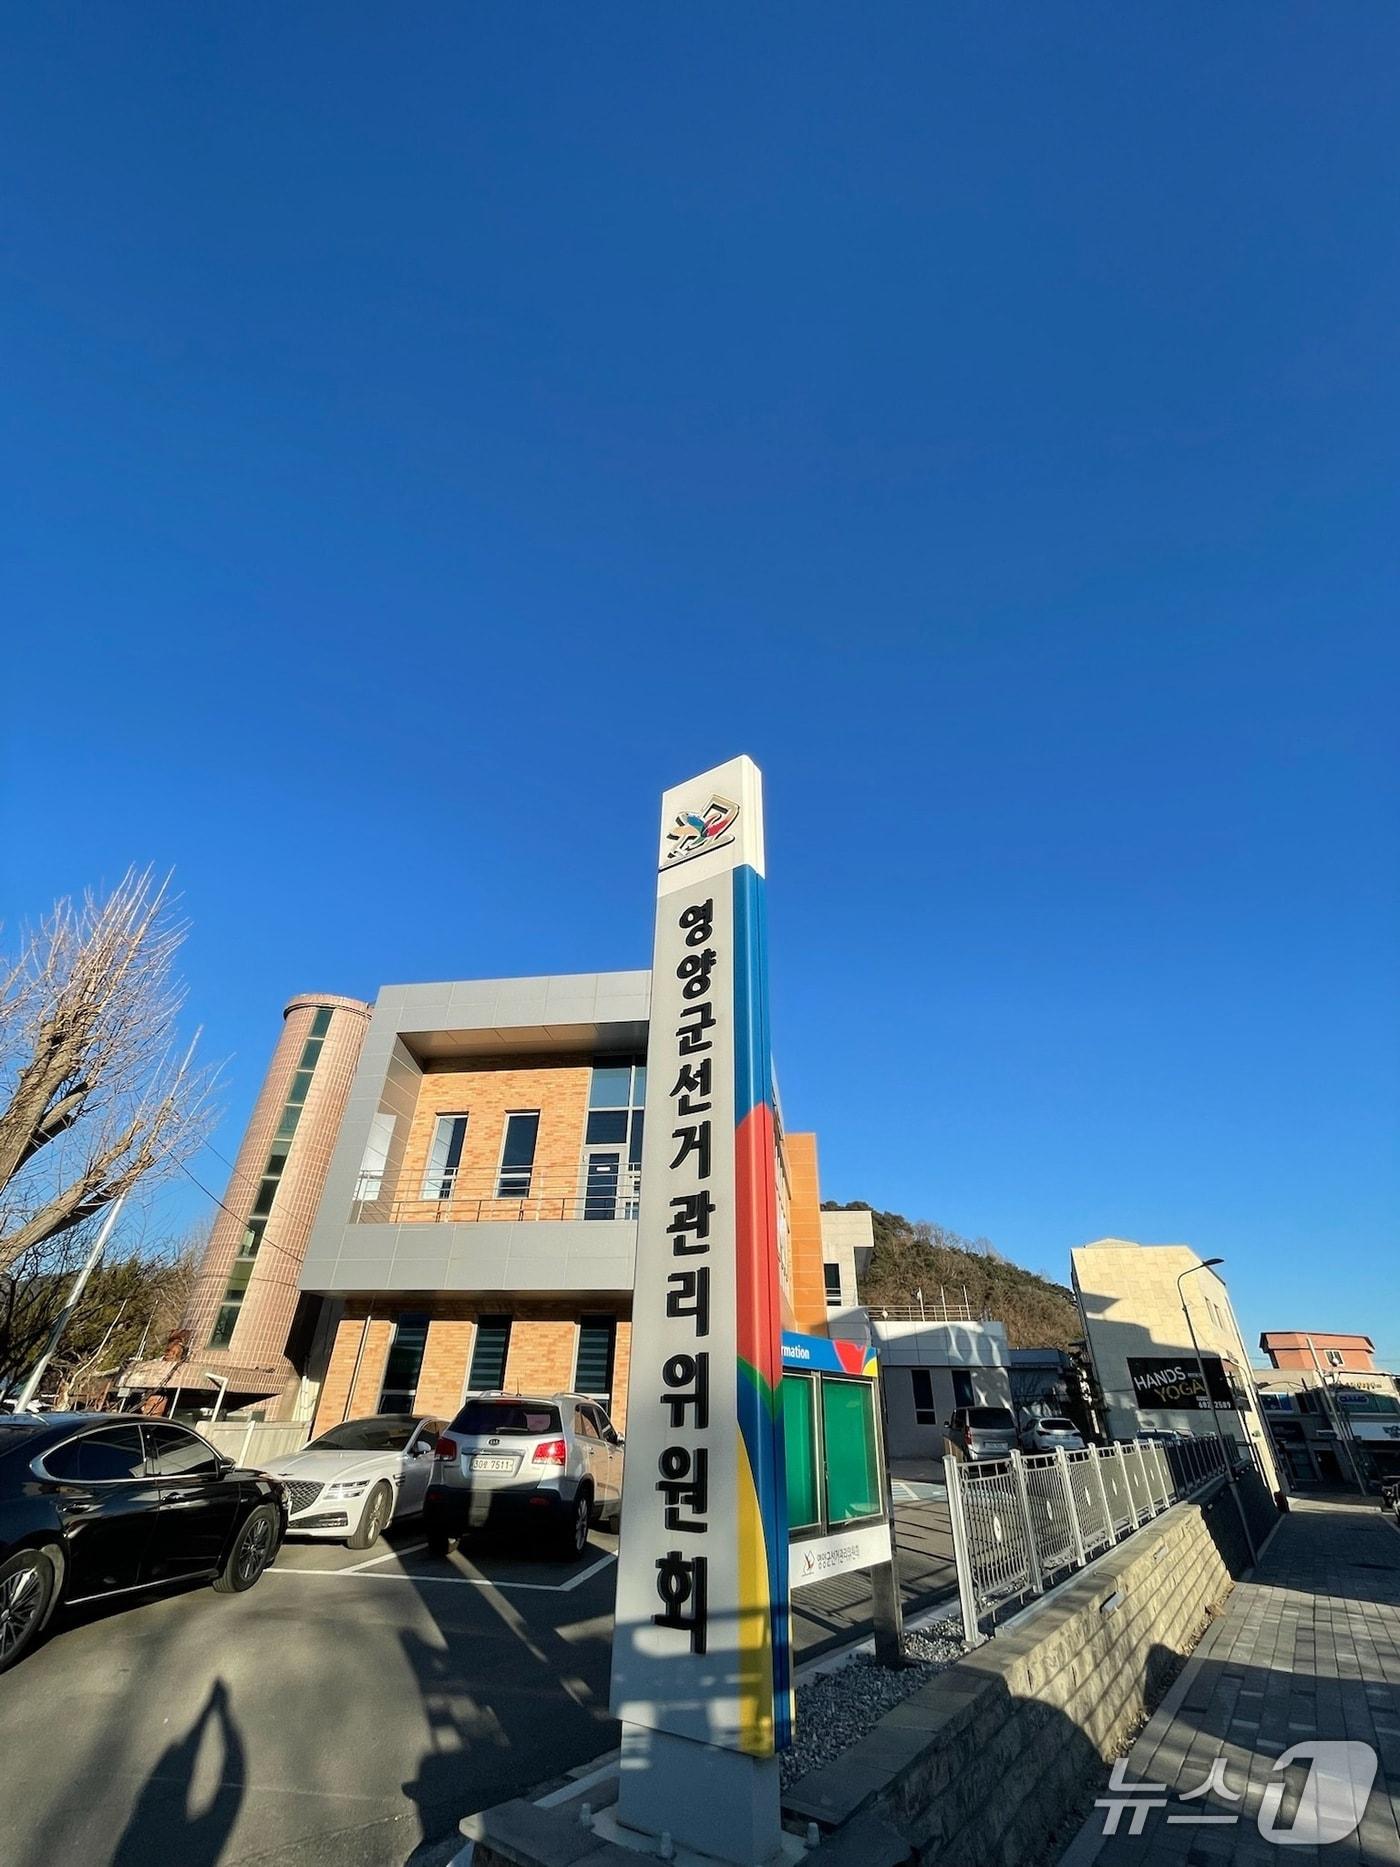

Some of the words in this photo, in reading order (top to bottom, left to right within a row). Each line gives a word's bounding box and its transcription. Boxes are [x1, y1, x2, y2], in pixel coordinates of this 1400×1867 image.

[651, 898, 717, 1655] 영양군선거관리위원회
[1134, 1366, 1186, 1391] HANDS
[1154, 1379, 1206, 1402] YOGA
